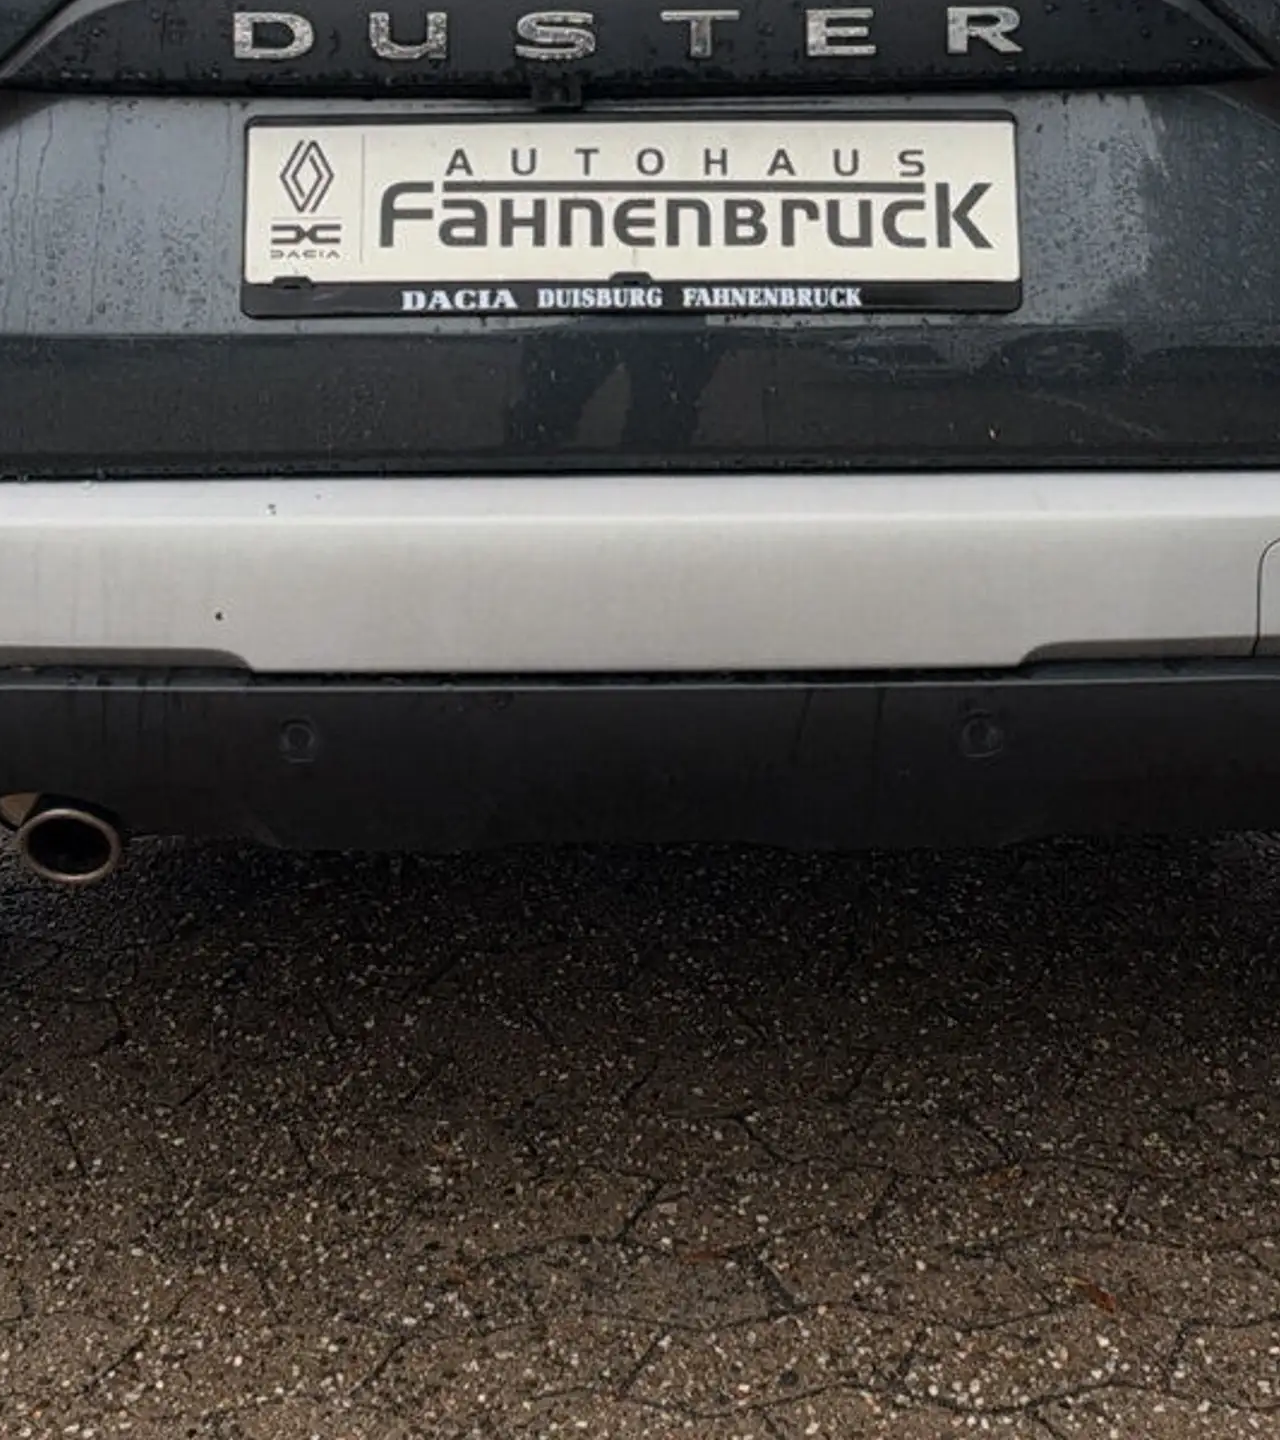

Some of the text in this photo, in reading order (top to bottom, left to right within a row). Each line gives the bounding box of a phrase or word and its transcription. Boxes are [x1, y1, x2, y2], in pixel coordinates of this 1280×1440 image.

[233, 6, 1023, 60] DUSTER
[445, 148, 926, 177] AUTOHAUS
[270, 249, 342, 259] DACIA
[402, 287, 863, 311] DACIA DUISBURG FAHNENBRUCK
